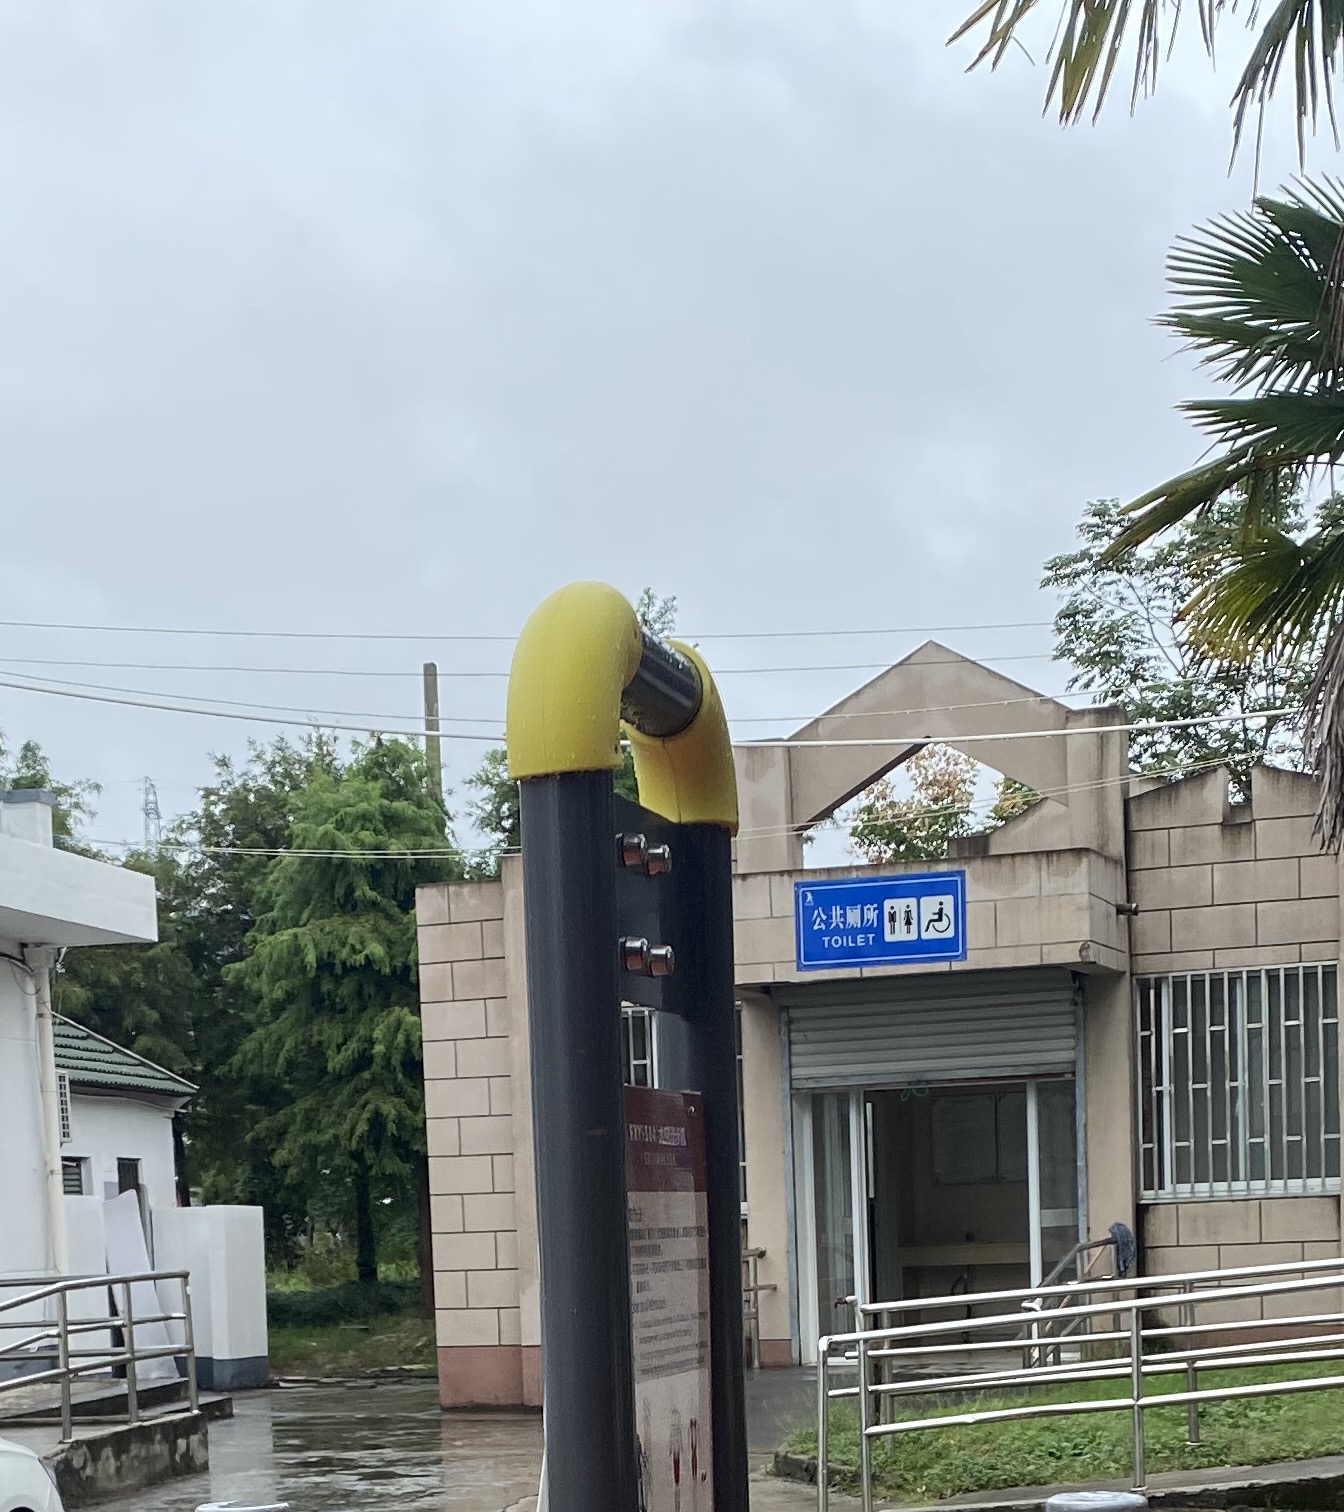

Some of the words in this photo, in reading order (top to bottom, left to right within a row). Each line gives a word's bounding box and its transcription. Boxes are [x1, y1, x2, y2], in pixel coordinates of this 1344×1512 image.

[812, 904, 879, 930] 公共厕所
[822, 933, 875, 948] TOILET
